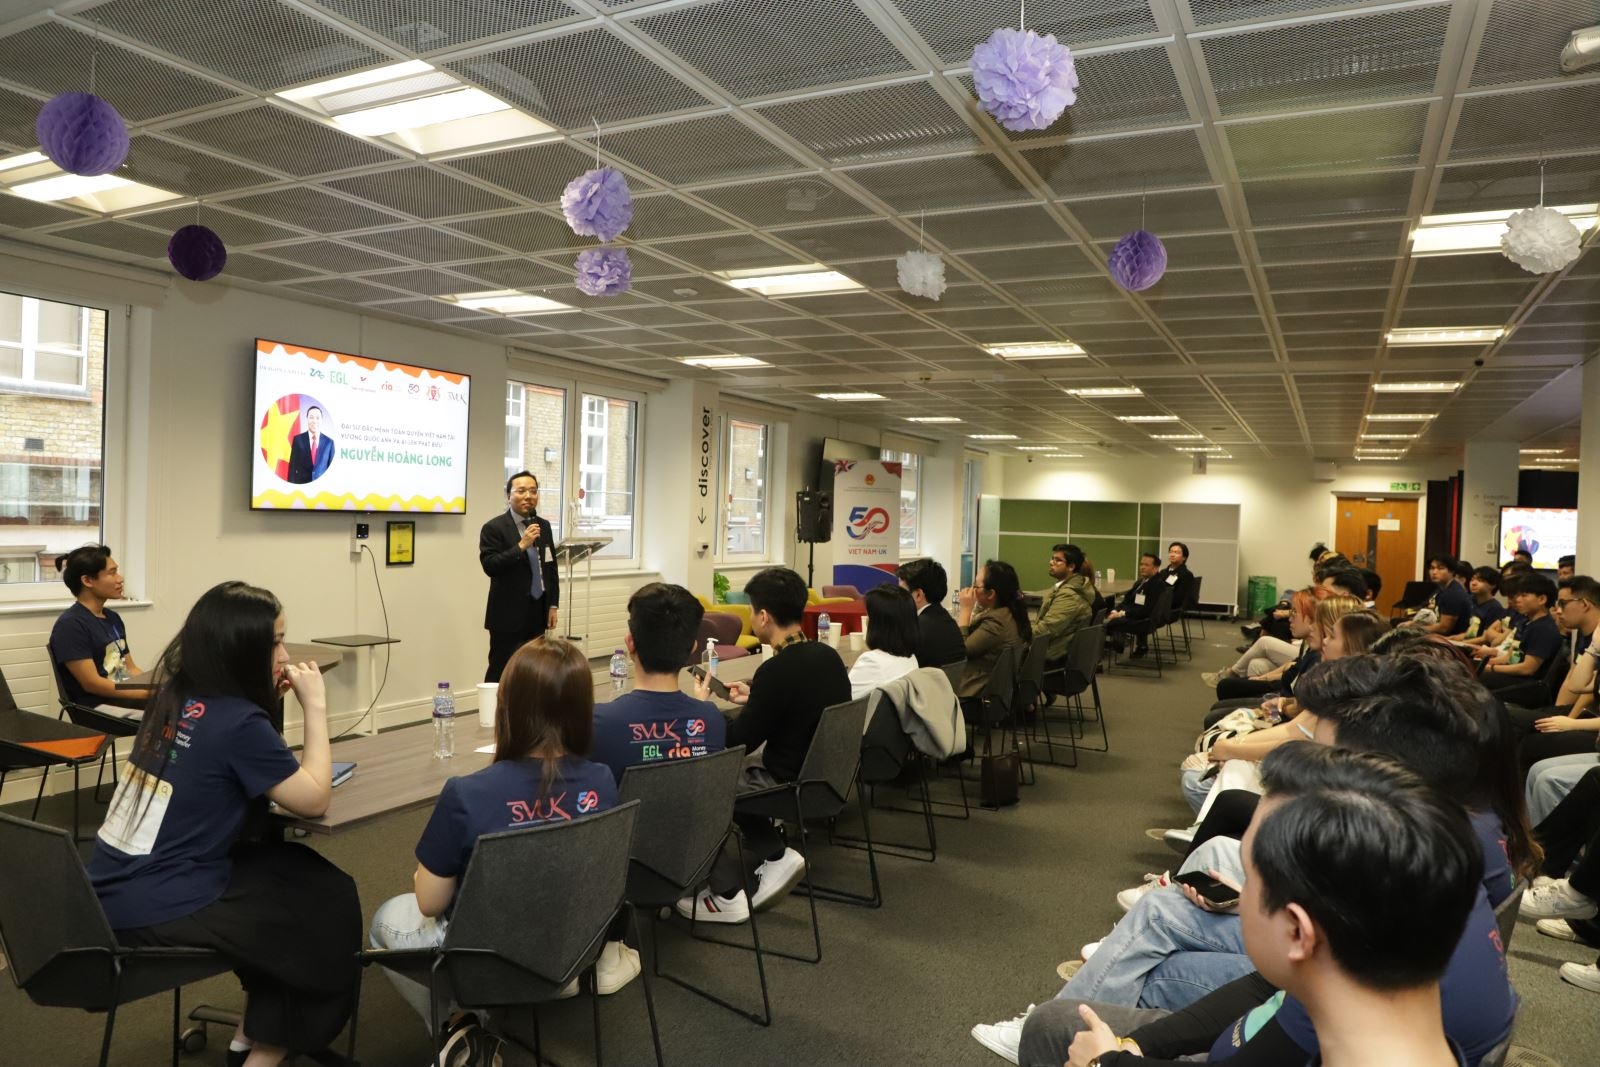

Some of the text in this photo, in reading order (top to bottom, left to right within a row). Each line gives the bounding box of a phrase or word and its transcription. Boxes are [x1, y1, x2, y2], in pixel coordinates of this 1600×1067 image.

[330, 370, 348, 385] EGL
[381, 380, 393, 391] ria
[340, 446, 452, 467] NGUYỄN HOÀNG LONG
[698, 406, 711, 497] discover
[629, 719, 681, 743] SVUK
[642, 742, 692, 759] EGL ria
